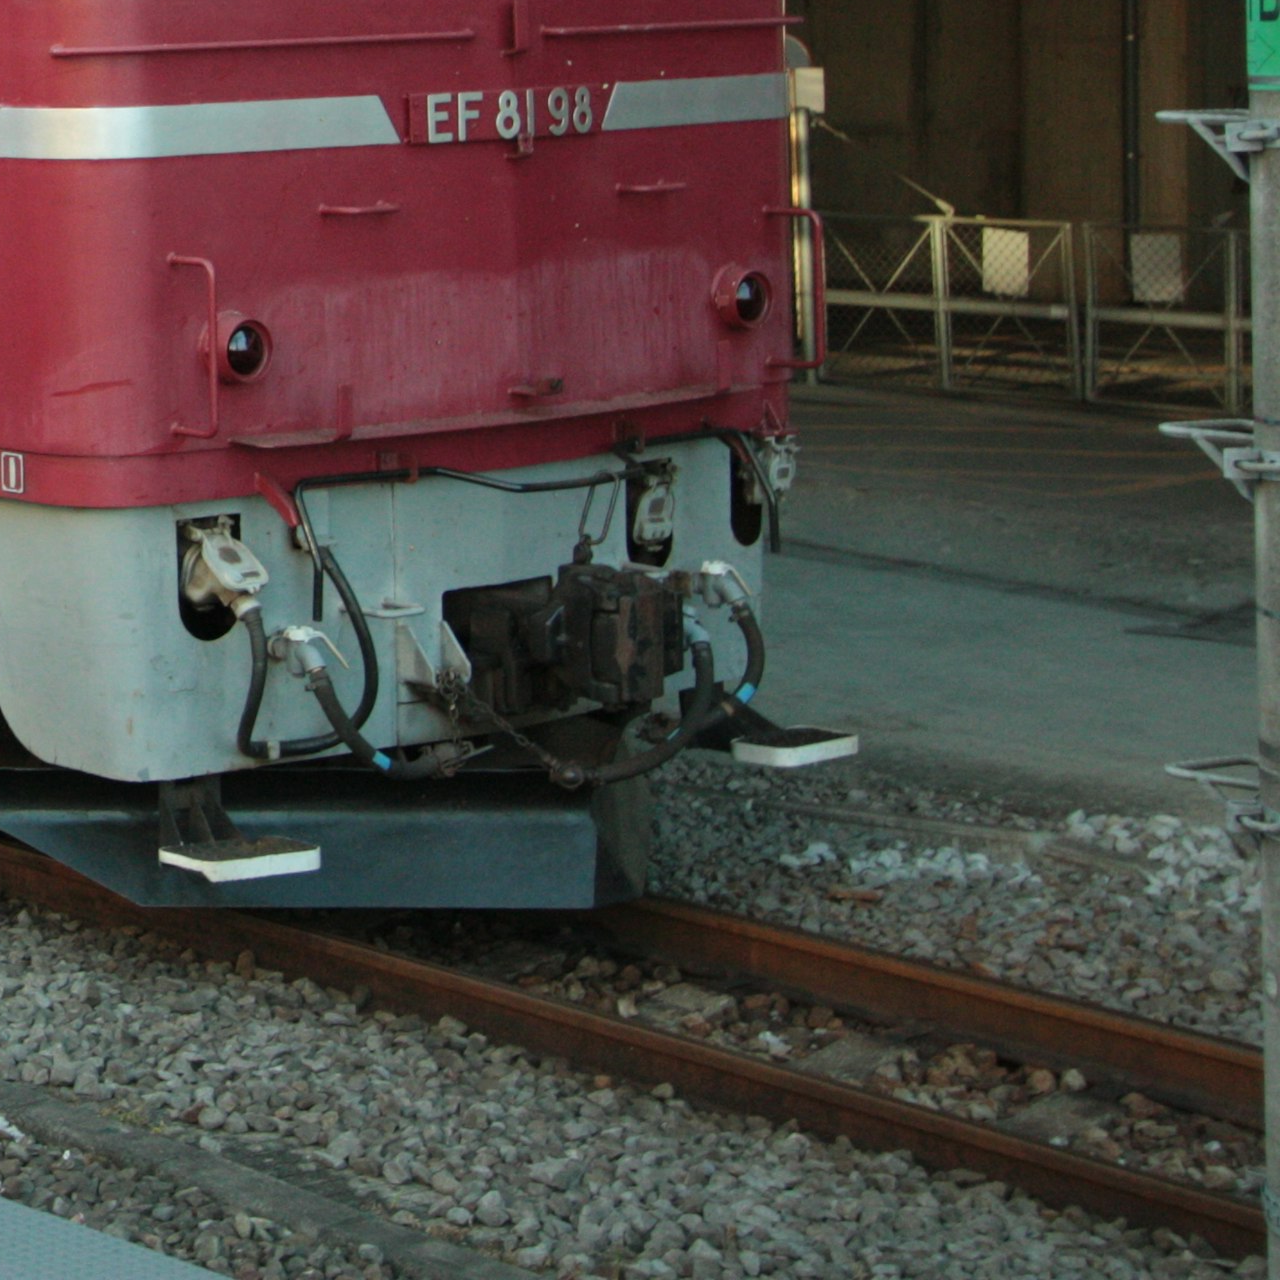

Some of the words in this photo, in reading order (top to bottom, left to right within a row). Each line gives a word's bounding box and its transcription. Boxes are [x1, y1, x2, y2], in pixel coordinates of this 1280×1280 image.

[426, 91, 483, 143] EF
[495, 89, 535, 140] 81
[547, 86, 593, 136] 98
